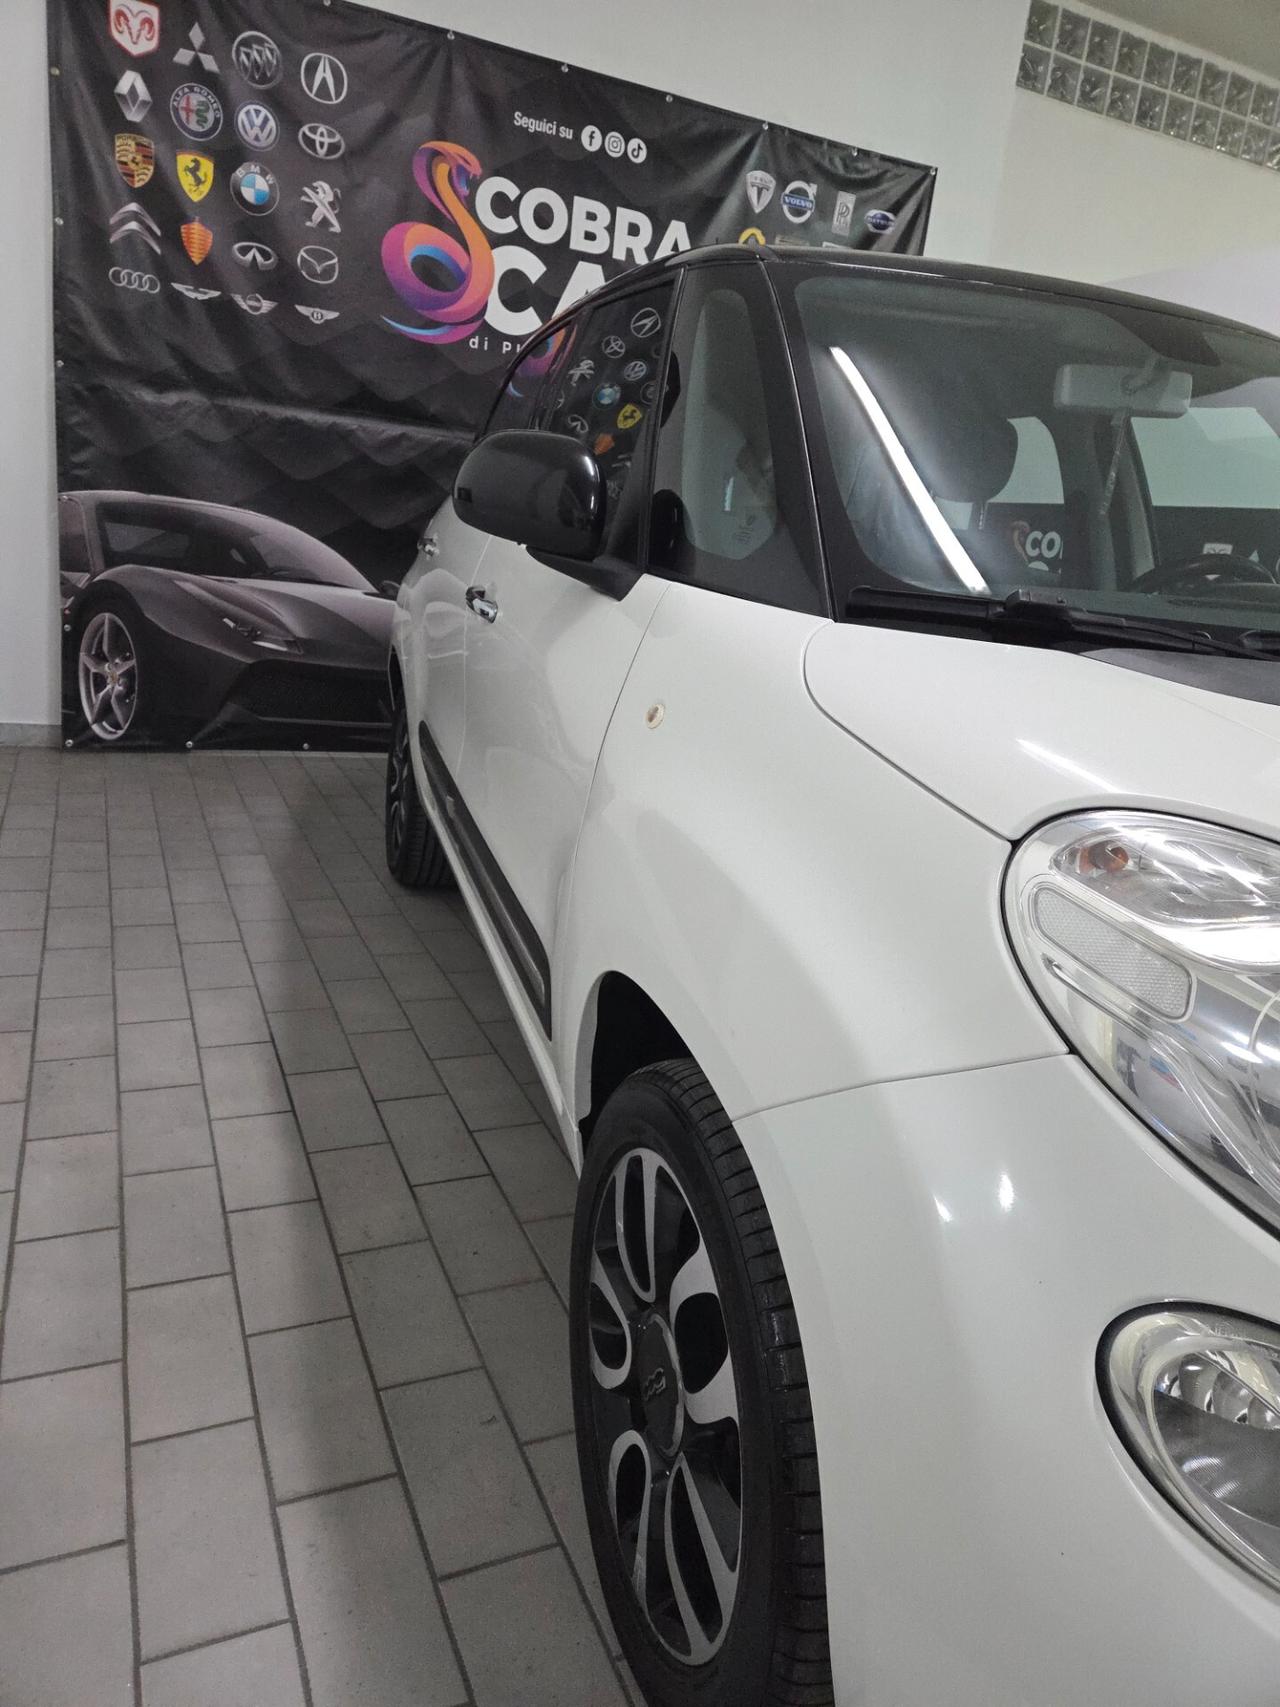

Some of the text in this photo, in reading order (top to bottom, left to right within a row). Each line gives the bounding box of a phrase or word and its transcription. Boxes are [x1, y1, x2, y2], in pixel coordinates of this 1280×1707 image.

[173, 87, 220, 118] ALFA ROMEO
[514, 111, 573, 139] Seguici su
[236, 164, 274, 184] BMW
[784, 195, 814, 209] VOLVO
[475, 176, 691, 266] COBRA
[469, 335, 489, 351] di
